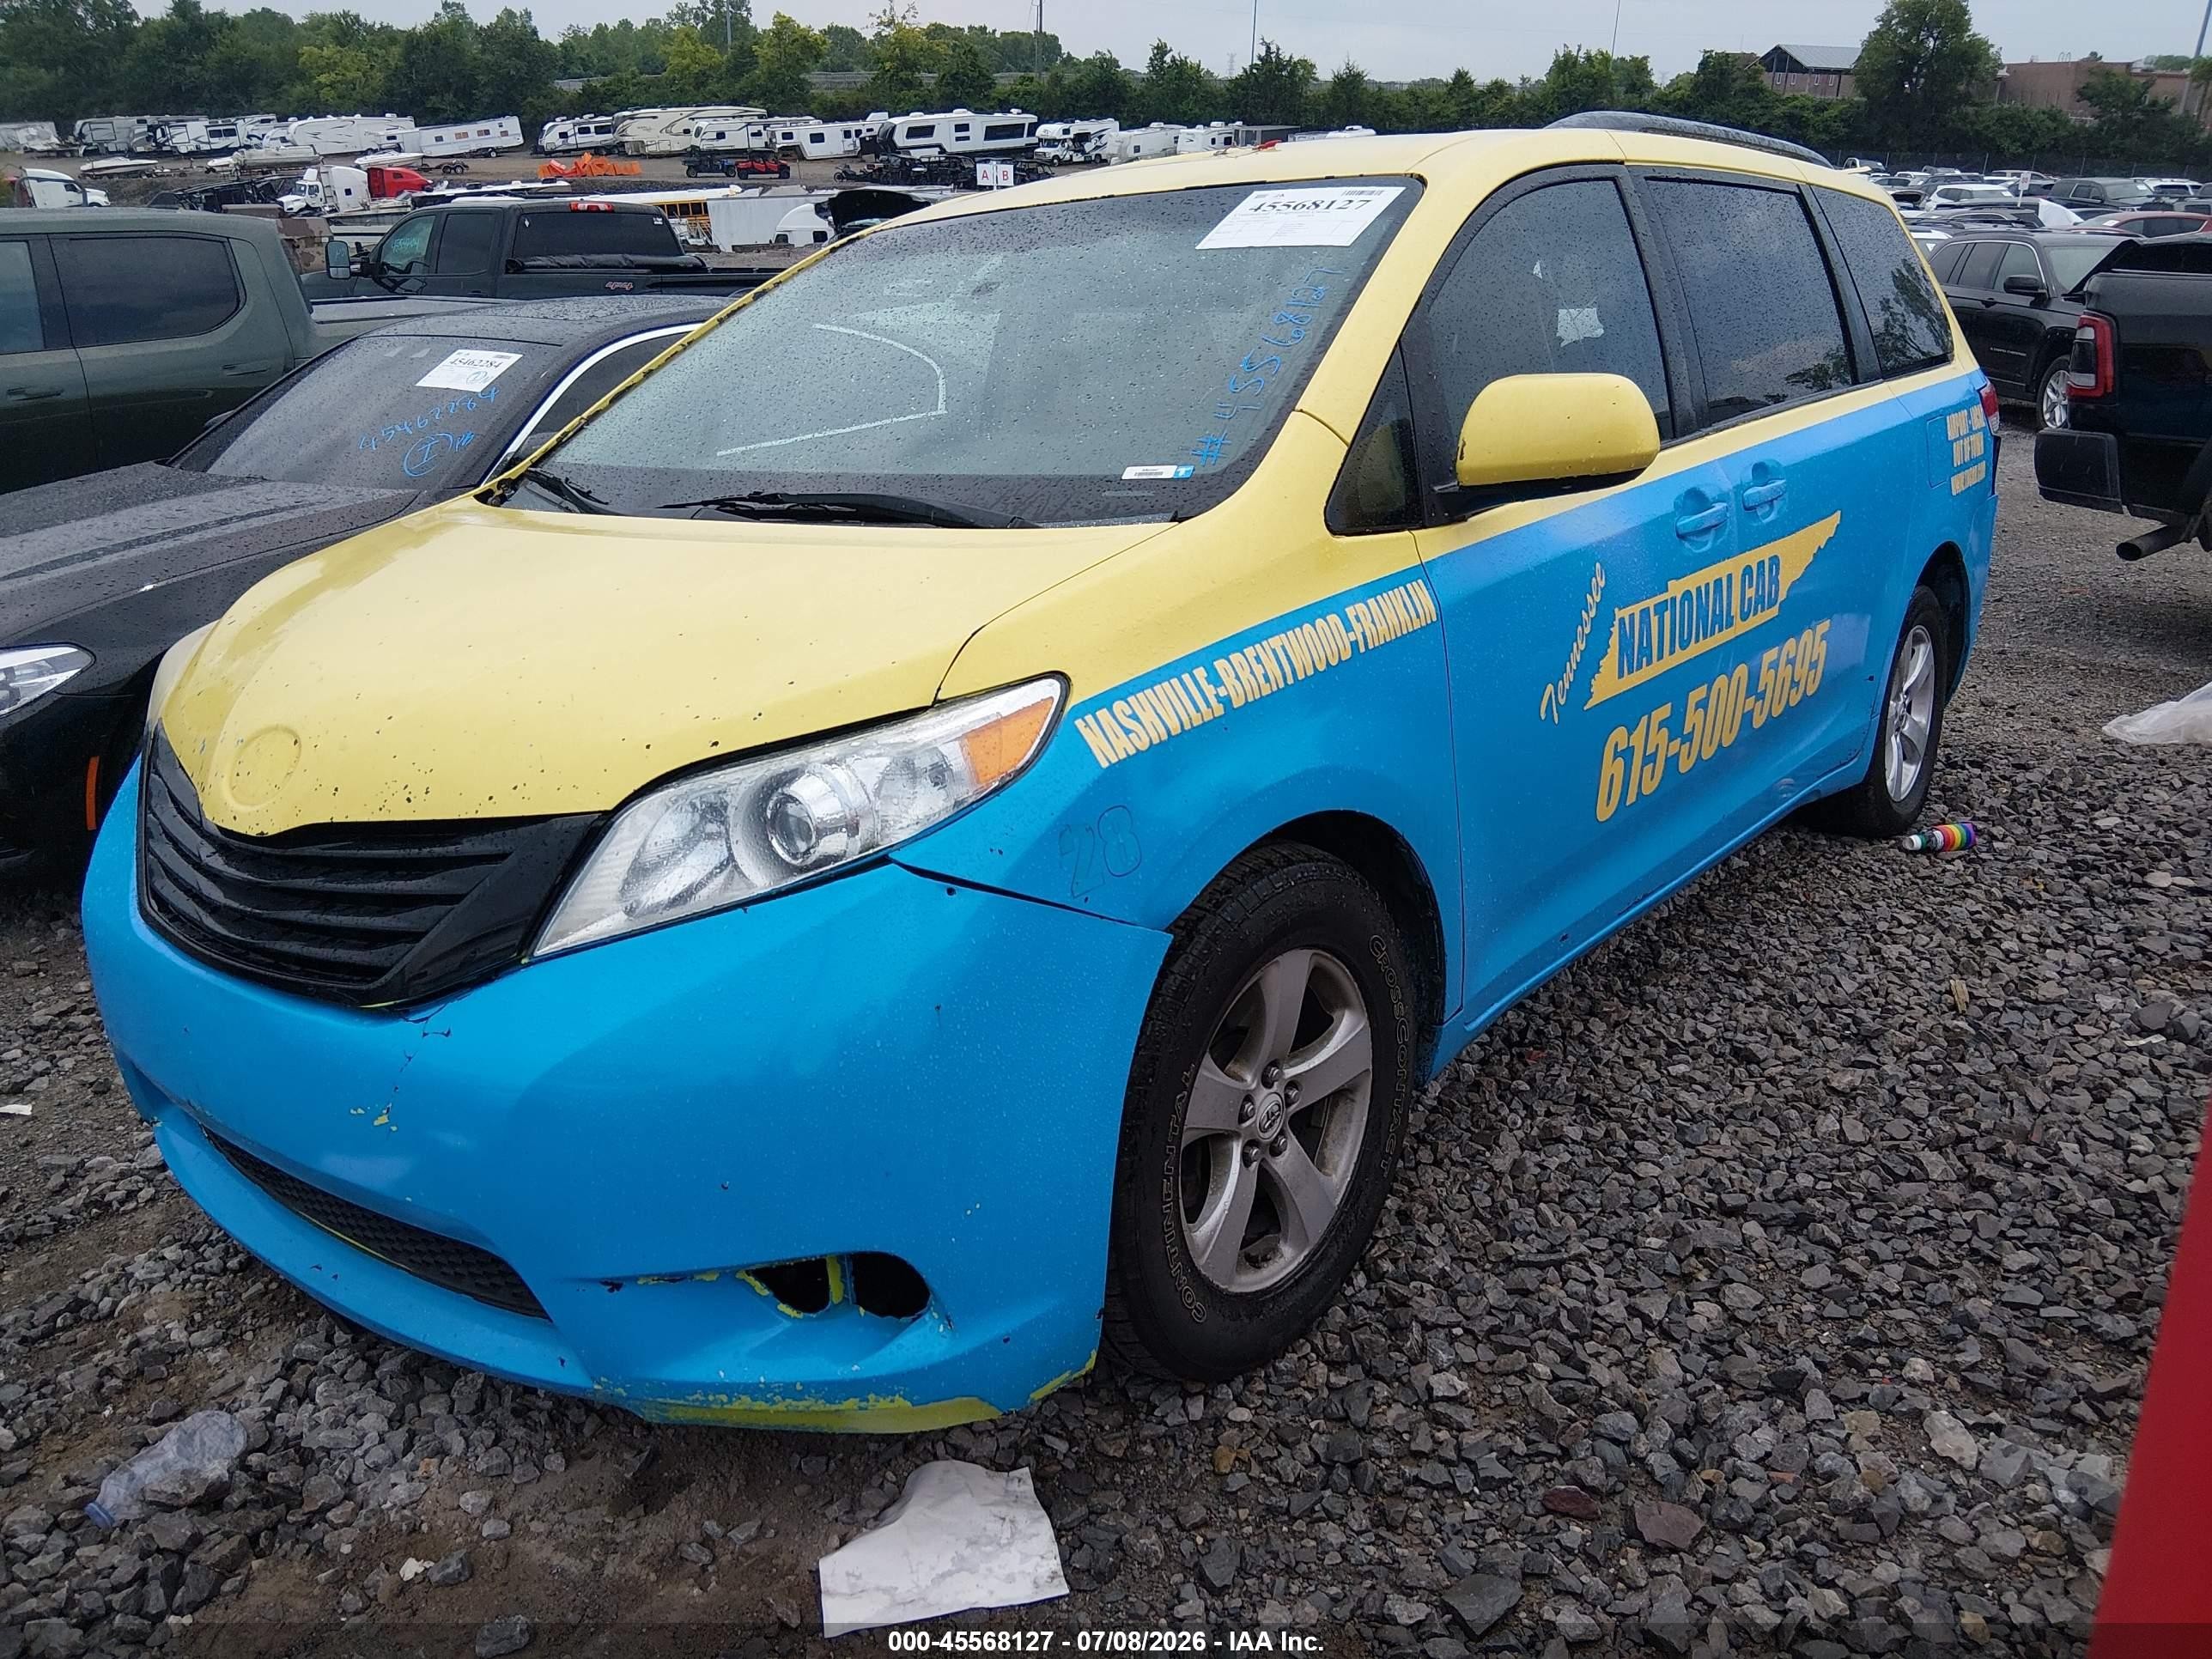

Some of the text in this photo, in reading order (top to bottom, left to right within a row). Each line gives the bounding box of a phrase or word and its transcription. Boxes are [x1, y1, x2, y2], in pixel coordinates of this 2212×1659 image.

[981, 169, 990, 181] A
[1002, 170, 1010, 181] B
[1249, 198, 1374, 214] 45568127
[450, 357, 504, 369] 45462284
[1540, 562, 1606, 725] Tennessee
[1616, 554, 1782, 681] NATIONAL CAB
[1073, 578, 1438, 769] NASHVILLE-BRENTWOOD-FRANKLIN
[1595, 618, 1832, 823] 615-500-5695
